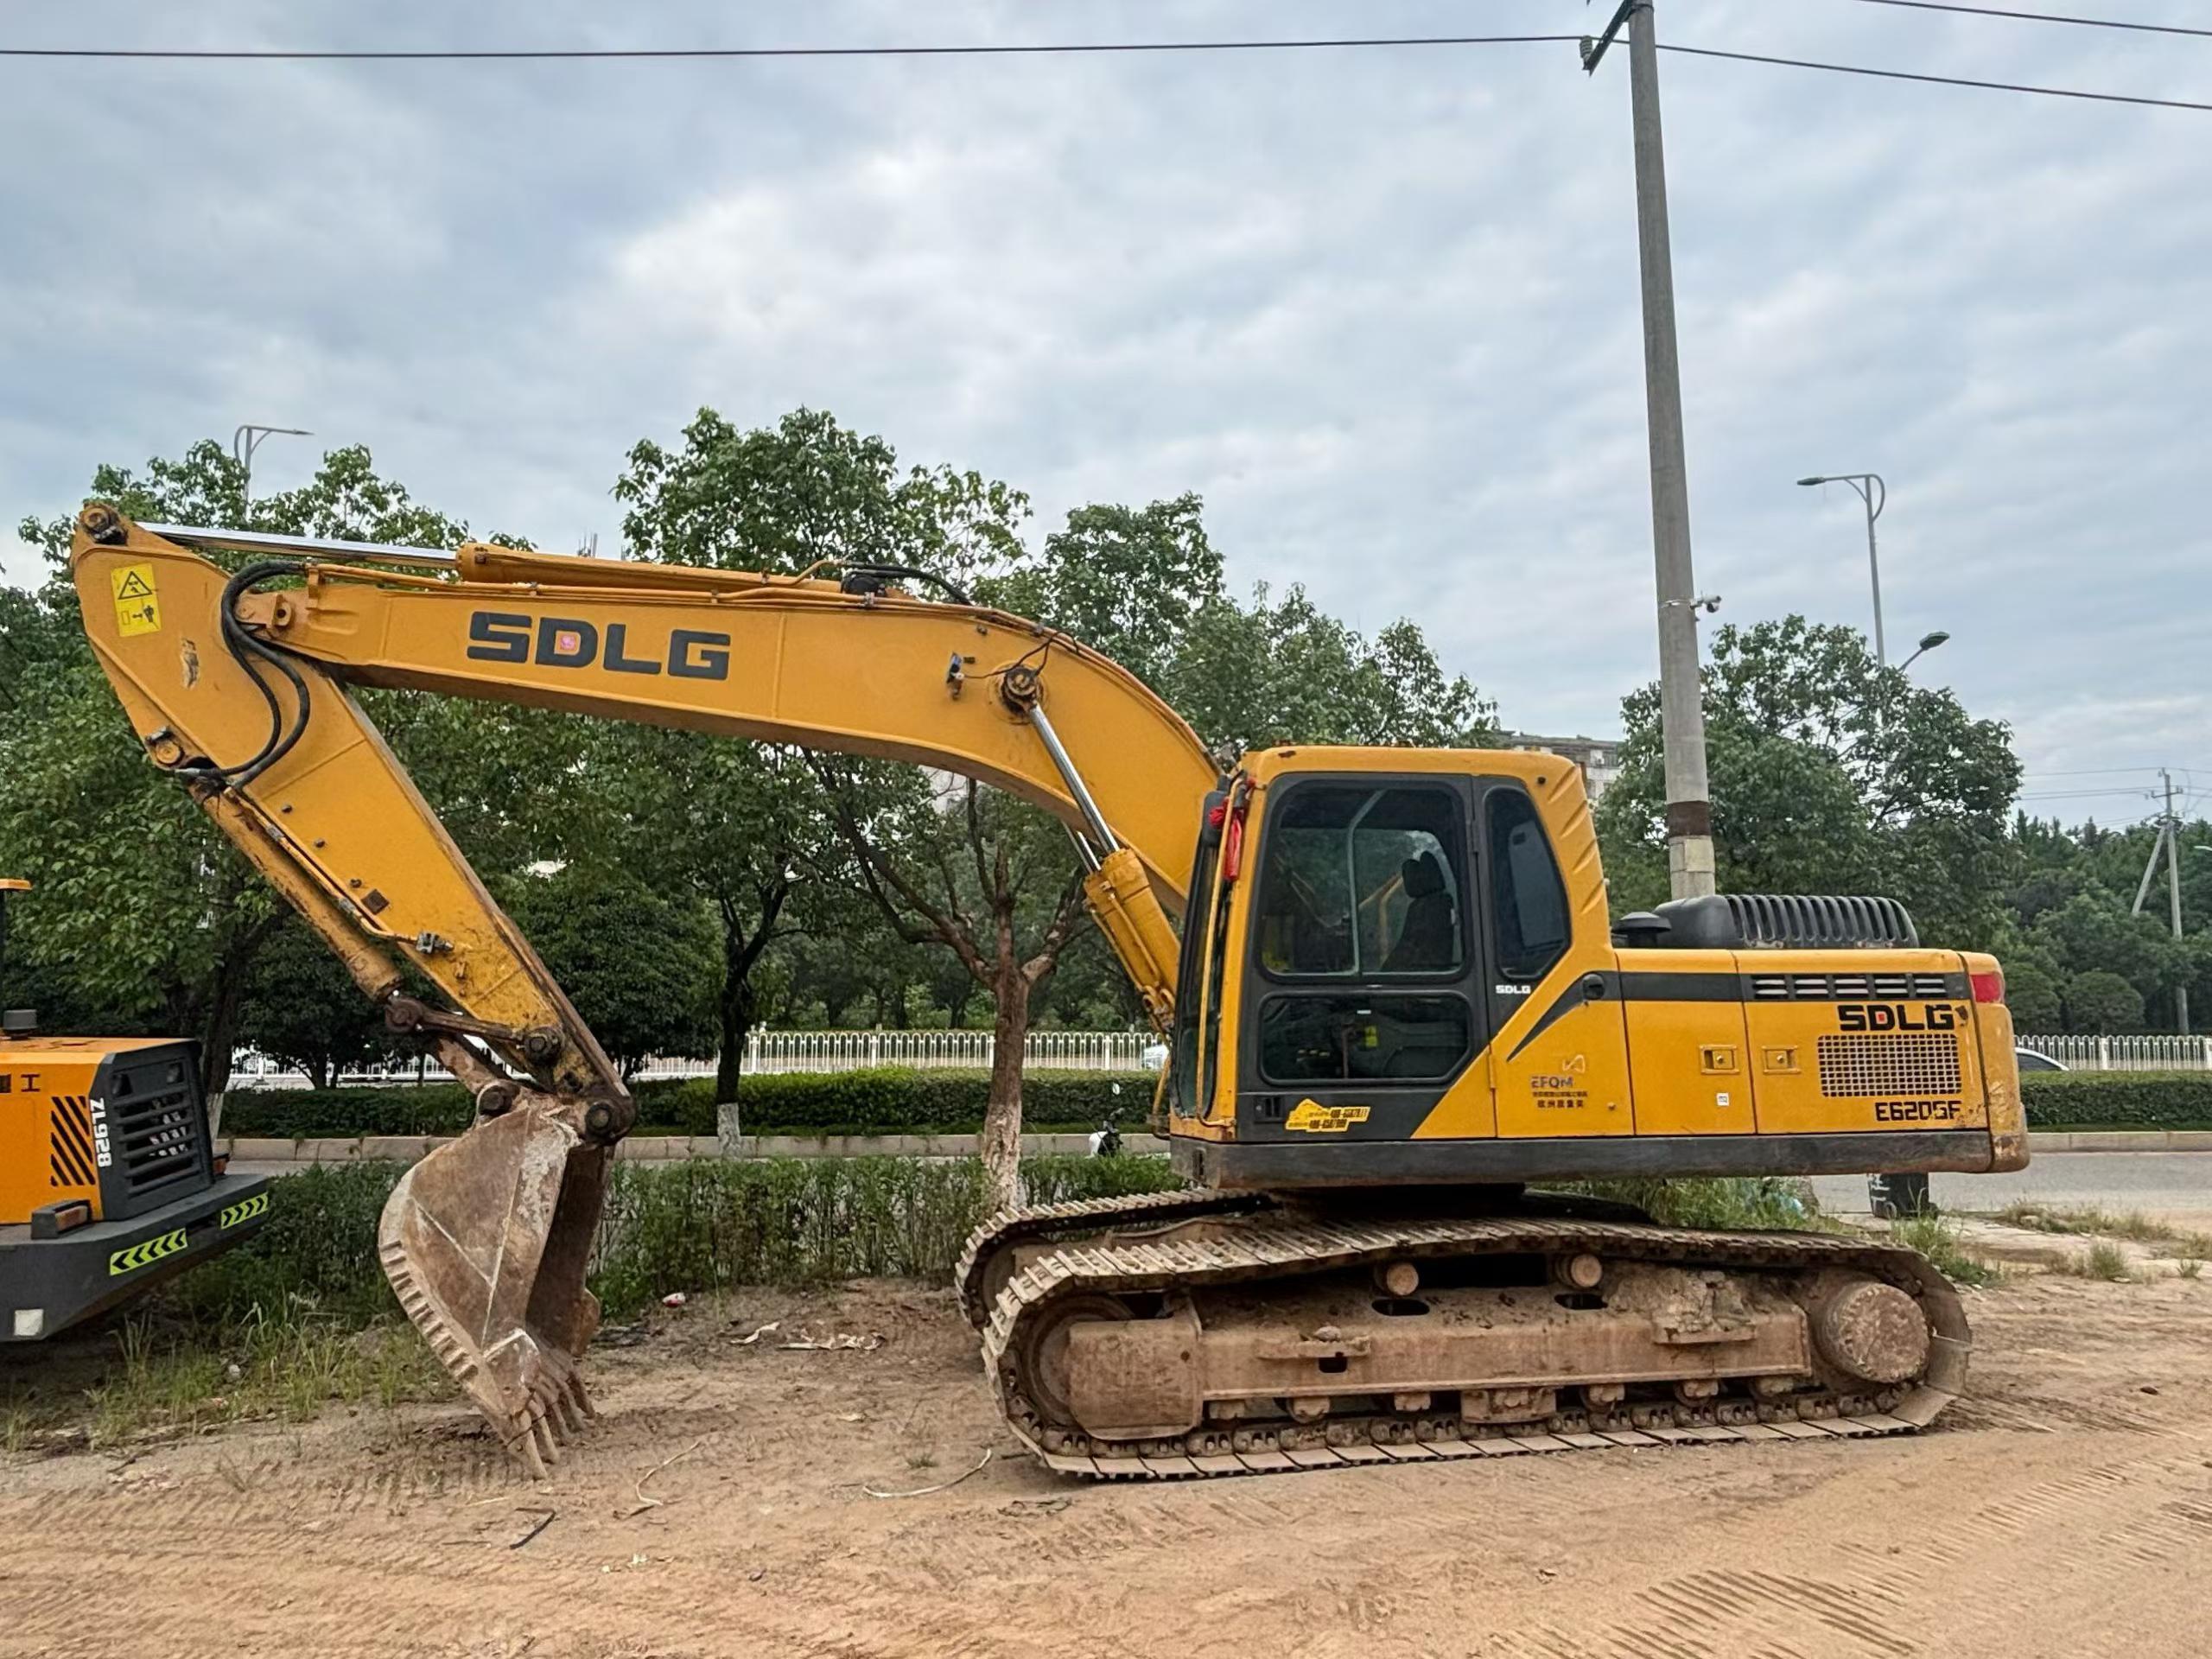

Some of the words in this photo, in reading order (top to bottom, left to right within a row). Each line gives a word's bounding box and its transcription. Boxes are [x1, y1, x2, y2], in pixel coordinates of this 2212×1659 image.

[467, 611, 730, 680] SDLG
[1495, 984, 1531, 995] SDLG
[1837, 1004, 1955, 1031] SDLG
[89, 1097, 112, 1167] ZL928
